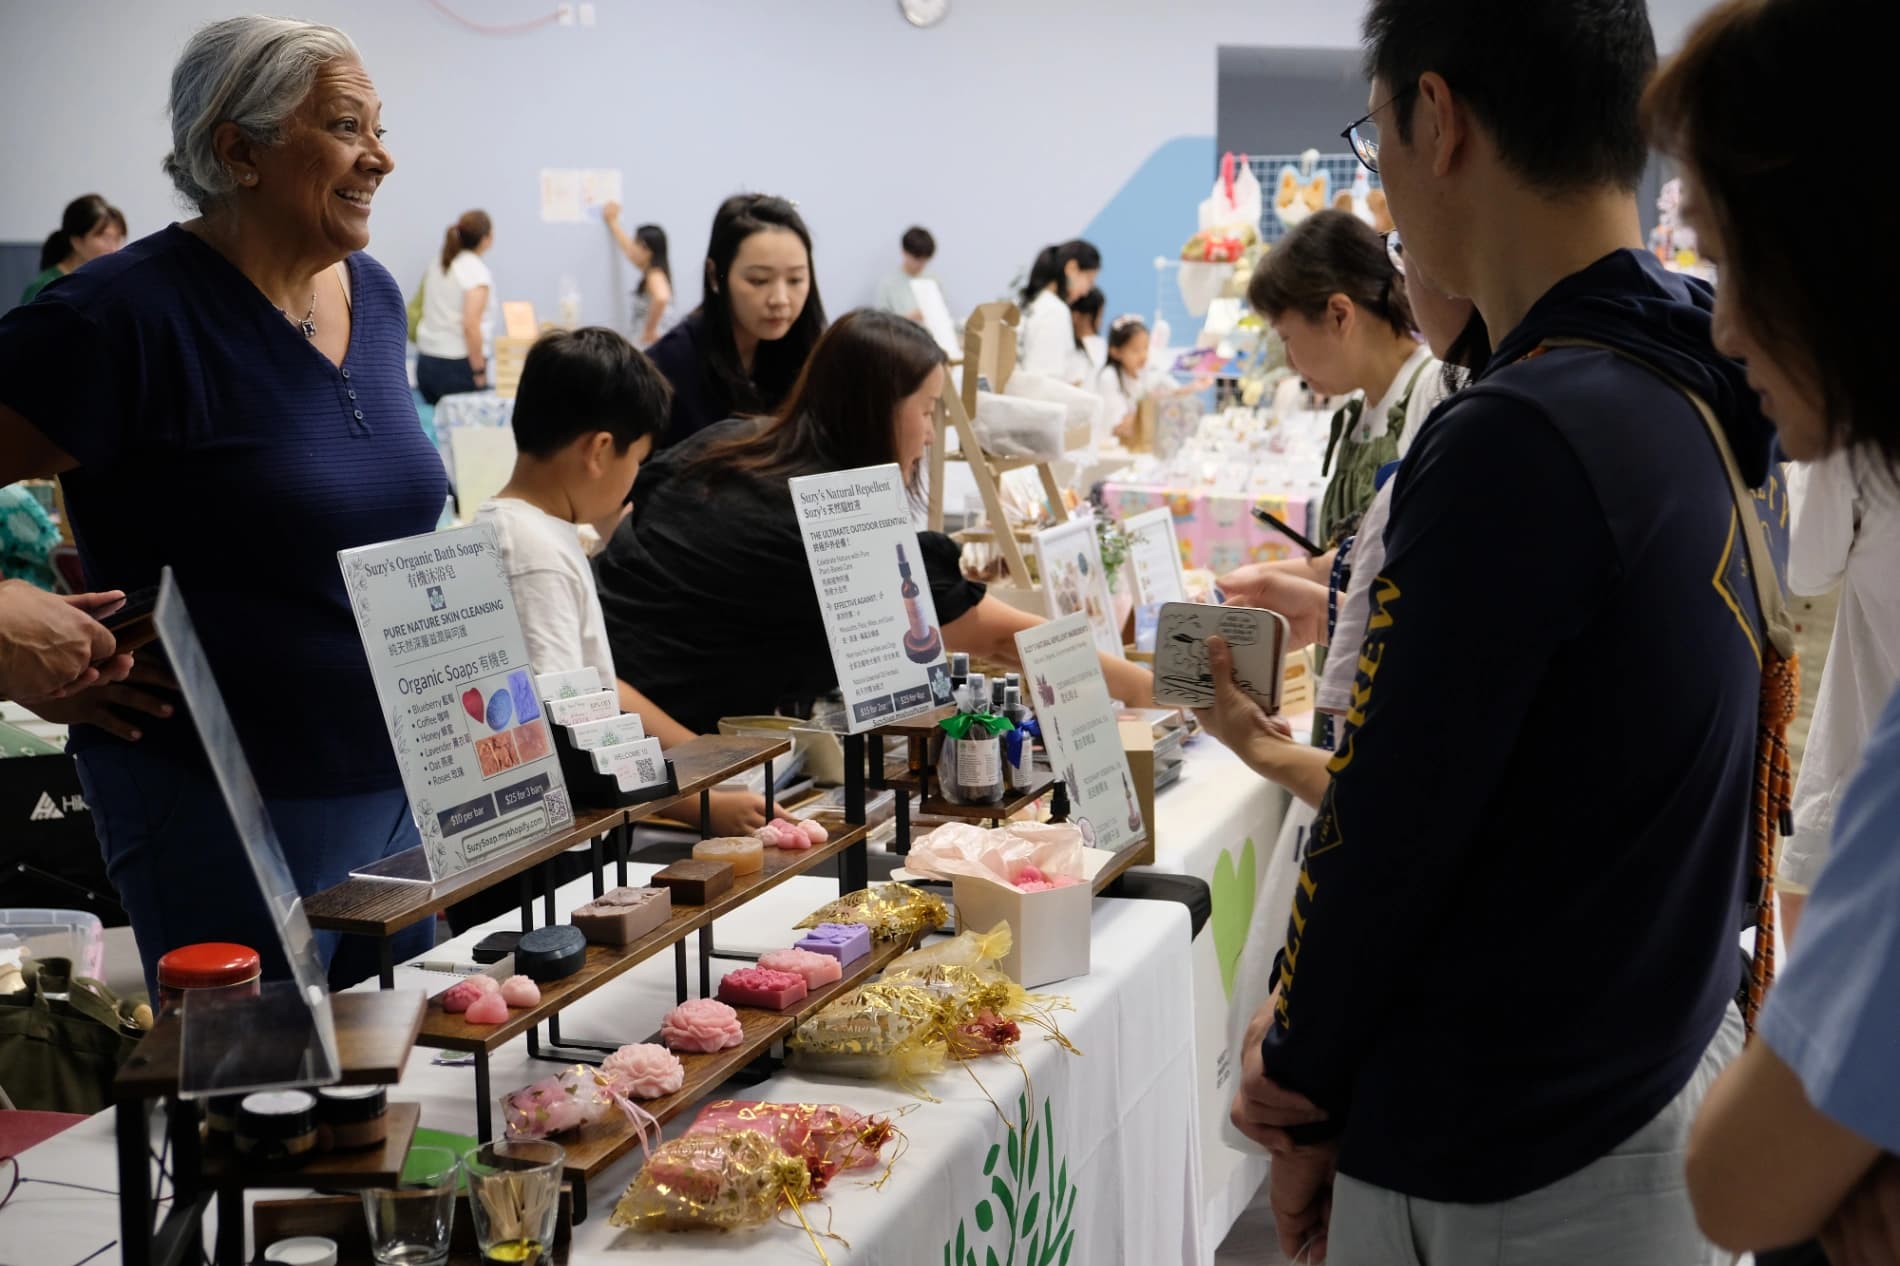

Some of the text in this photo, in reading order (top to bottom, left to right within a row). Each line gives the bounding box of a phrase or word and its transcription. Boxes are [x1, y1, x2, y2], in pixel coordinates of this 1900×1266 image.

[800, 480, 891, 506] Suzy's Natural Repellent
[804, 506, 827, 519] Suzy's
[810, 531, 822, 541] THE
[821, 526, 850, 540] ULTIMATE
[850, 521, 880, 534] OUTDOOR
[364, 541, 484, 577] Suzy's Organic Bath Soaps
[383, 599, 504, 640] PURE NATURE SKIN CLEANSING
[398, 668, 445, 695] Organic
[444, 661, 479, 682] Soaps
[412, 698, 442, 715] Blueberry
[504, 792, 519, 806] $25
[450, 812, 463, 827] $10
